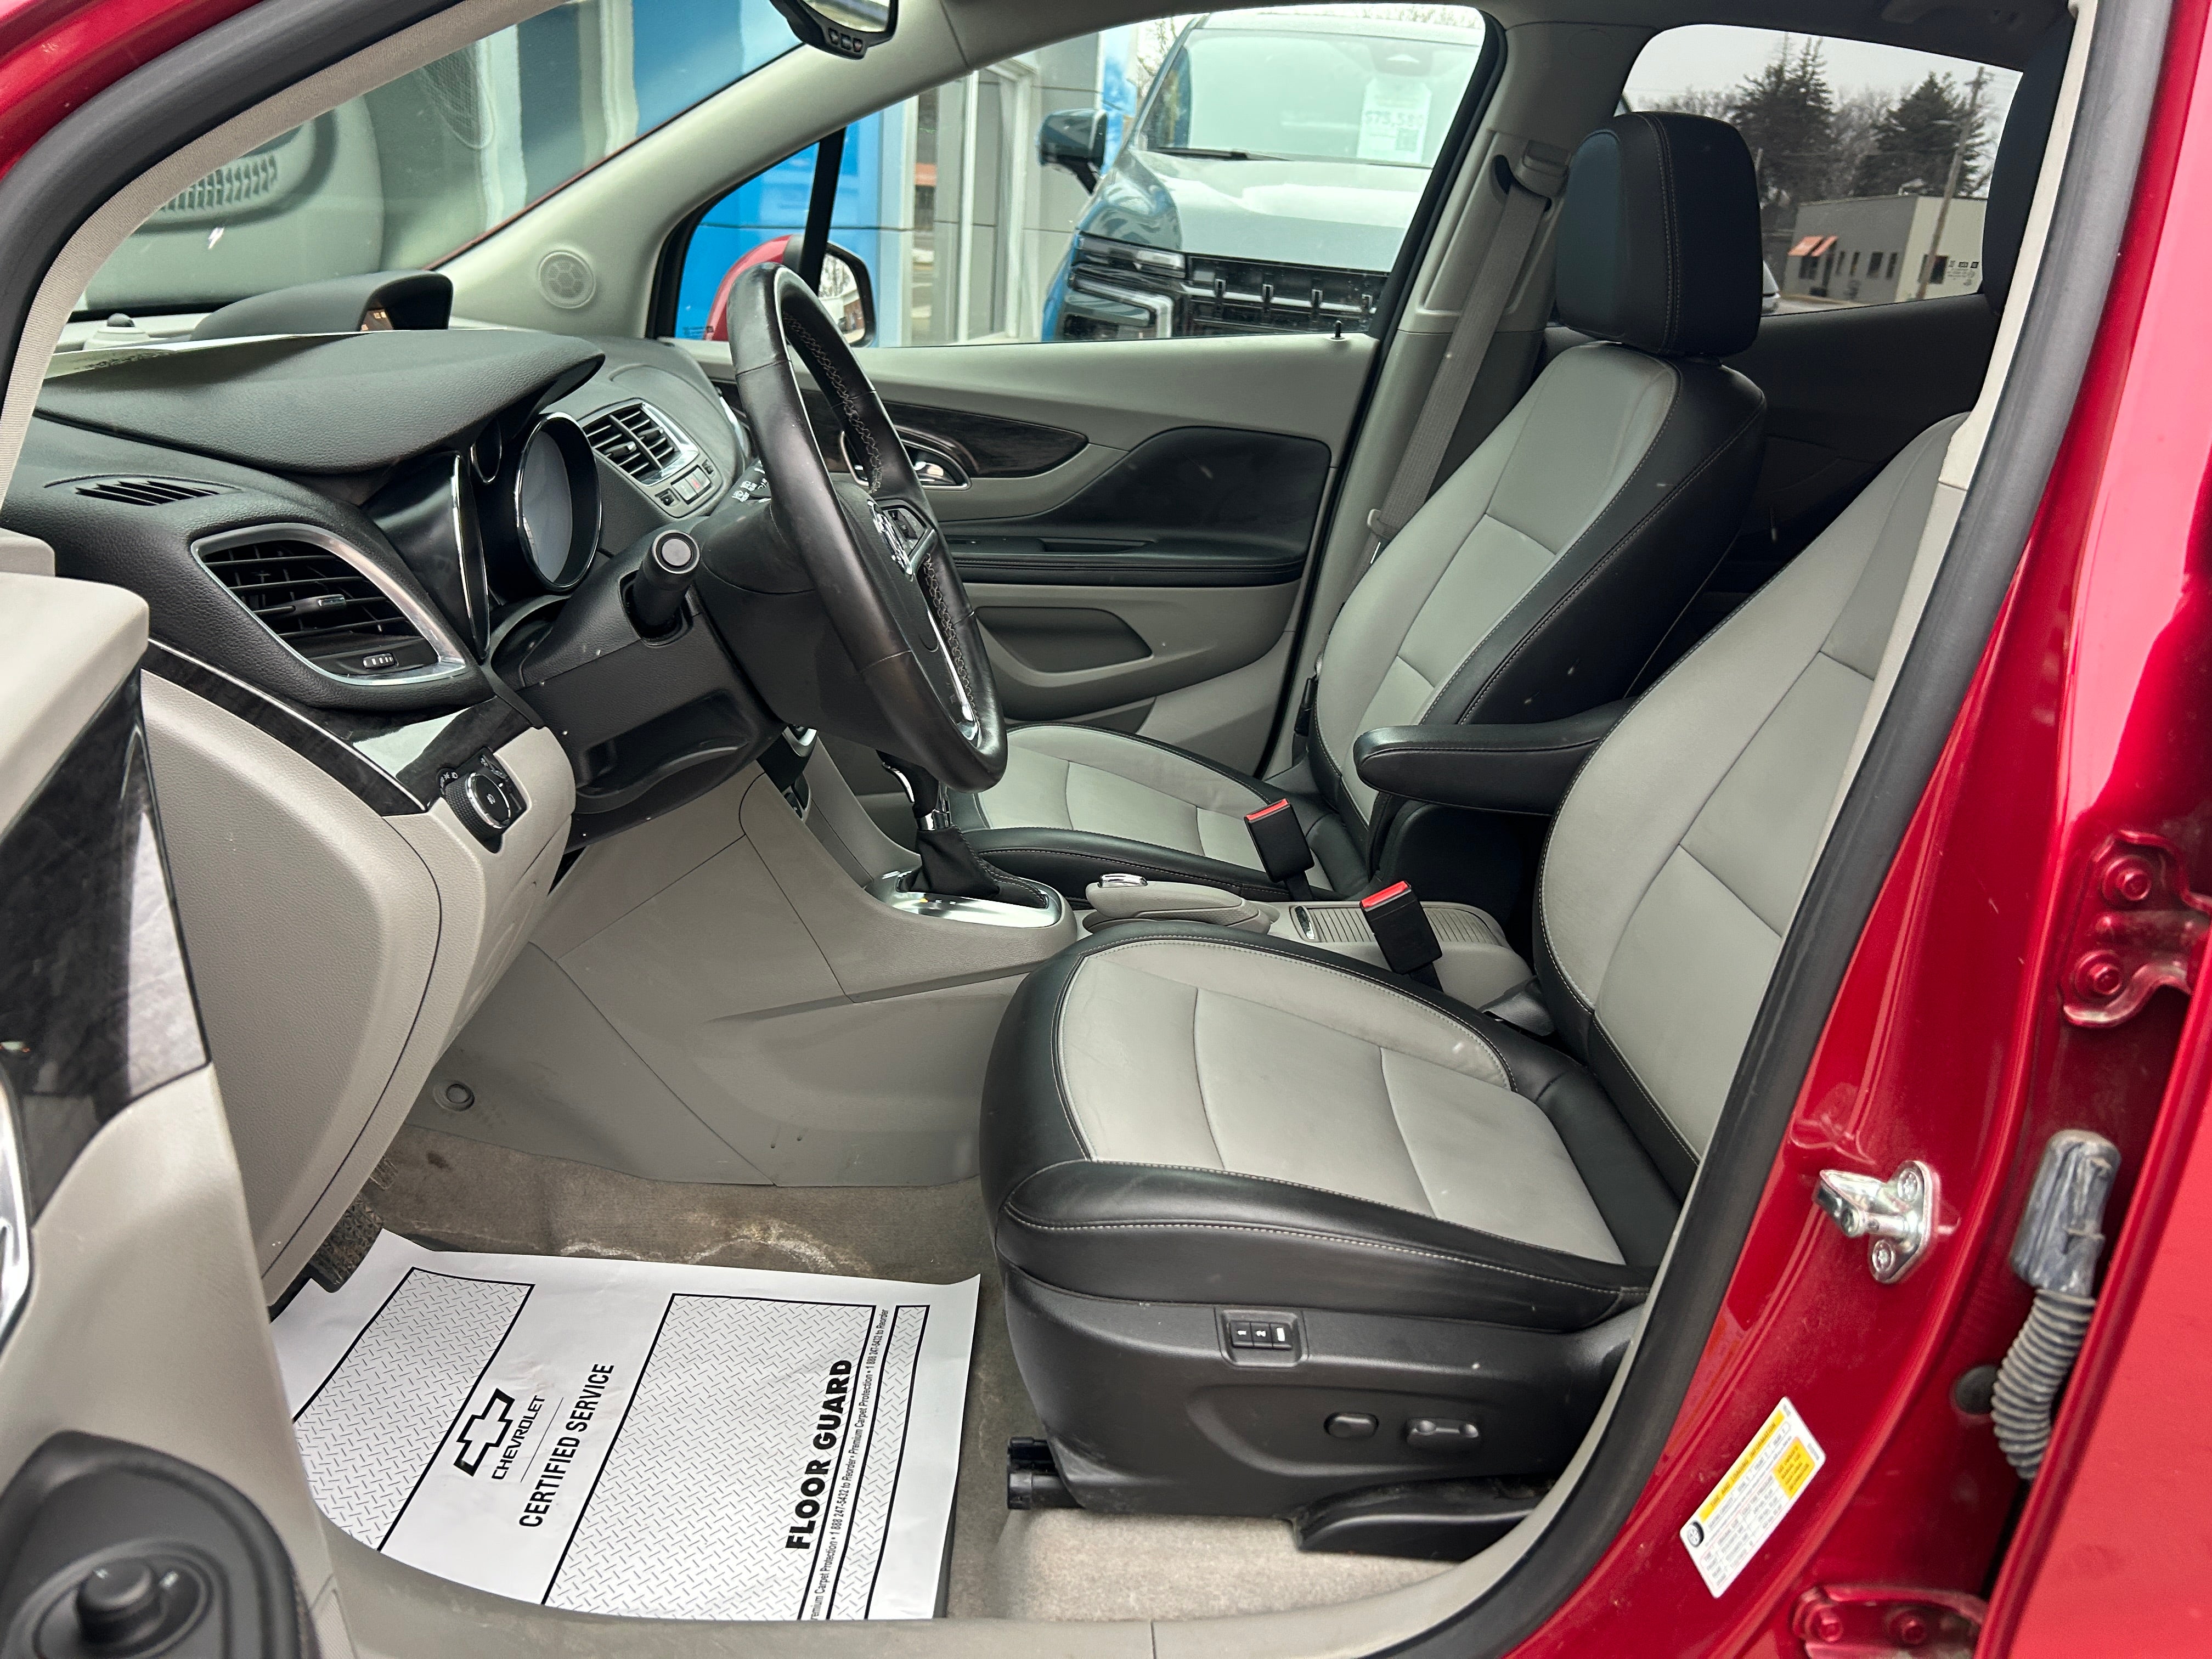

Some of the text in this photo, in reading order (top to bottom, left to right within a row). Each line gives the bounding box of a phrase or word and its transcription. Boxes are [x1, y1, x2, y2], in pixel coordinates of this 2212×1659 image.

[876, 1309, 889, 1329] Reorder
[868, 1335, 882, 1355] 247-5432
[866, 1356, 877, 1364] 888
[859, 1374, 873, 1406] Protection
[855, 1408, 868, 1427] Carpet
[492, 1395, 545, 1480] CHEVROLET
[519, 1364, 614, 1527] CERTIFIED SERVICE
[848, 1429, 863, 1454] Premium
[785, 1360, 851, 1549] FLOOR GUARD
[842, 1458, 856, 1481] Reorder
[1721, 1482, 1730, 1496] AND
[833, 1489, 849, 1517] 247-5432
[831, 1519, 843, 1530] 888
[820, 1541, 838, 1571] Protection
[814, 1573, 830, 1594] Carpet
[810, 1595, 823, 1620] remium
